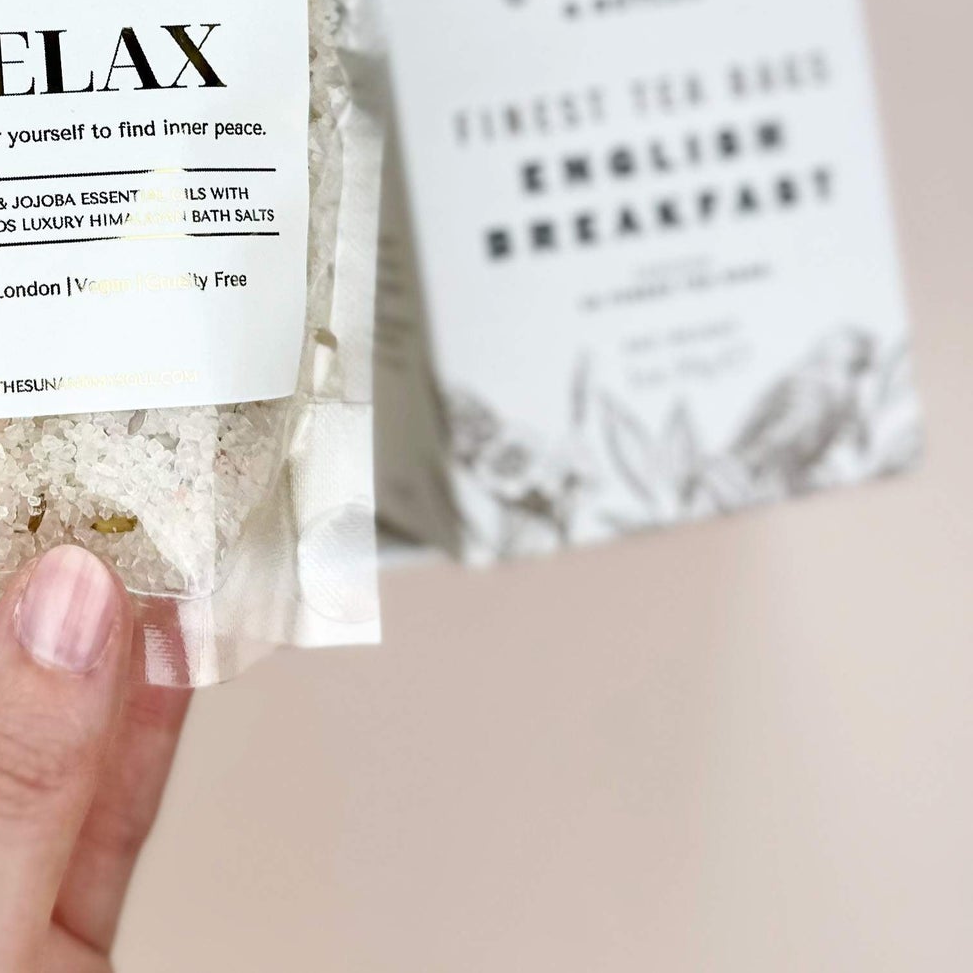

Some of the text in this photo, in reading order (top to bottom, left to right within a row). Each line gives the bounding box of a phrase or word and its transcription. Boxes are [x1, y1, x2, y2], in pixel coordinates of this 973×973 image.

[8, 124, 85, 149] yourself
[91, 123, 112, 139] to
[118, 120, 156, 138] find
[163, 119, 209, 136] inner
[215, 122, 267, 140] peace.
[521, 119, 784, 195] ENGLISH
[12, 193, 77, 210] JOJOBA
[211, 186, 250, 200] WITH
[22, 214, 85, 231] LUXURY
[192, 208, 231, 223] BATH
[235, 208, 275, 222] SALTS
[484, 166, 832, 263] BREAKFAST
[214, 270, 248, 288] Free
